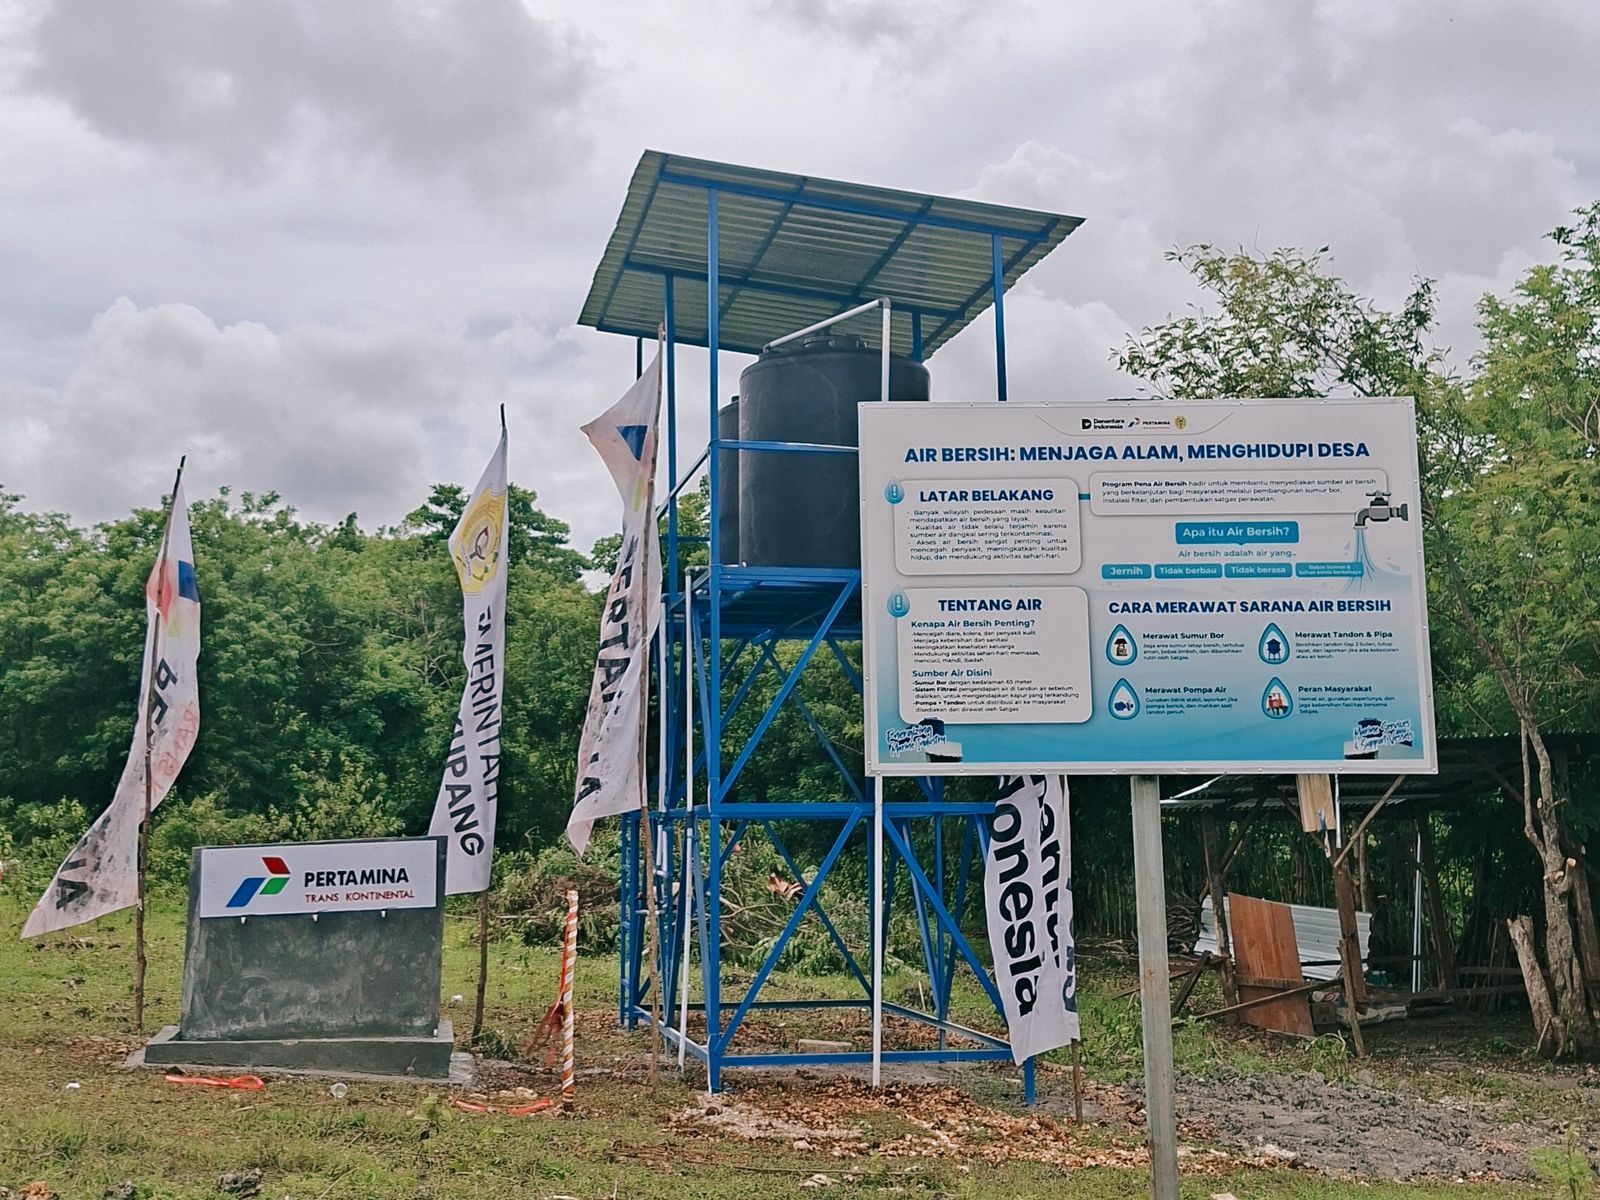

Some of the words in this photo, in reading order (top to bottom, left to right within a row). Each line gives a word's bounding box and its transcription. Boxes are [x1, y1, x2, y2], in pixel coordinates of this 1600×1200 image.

[904, 448, 936, 462] AIR
[942, 447, 1015, 462] BERSIH:
[1020, 446, 1118, 461] MENJAGA
[1122, 445, 1183, 462] ALAM,
[1188, 443, 1313, 459] MENGHIDUPI
[1318, 443, 1369, 457] DESA
[1270, 479, 1315, 487] menyediakan
[920, 490, 968, 502] LATAR
[972, 489, 1054, 501] BELAKANG
[1169, 488, 1184, 496] bagi
[1185, 488, 1226, 496] masyarakat
[1253, 487, 1304, 495] pembangunan
[1164, 496, 1213, 504] pembentukan
[1214, 496, 1236, 504] satgas
[973, 508, 1006, 516] pedesaan
[910, 516, 958, 524] mendapatkan
[1011, 515, 1029, 523] layak.
[978, 530, 999, 538] sering
[1183, 527, 1206, 538] Apa
[1209, 527, 1223, 536] itu
[1227, 527, 1244, 536] Air
[1247, 526, 1289, 536] Bersih?
[910, 546, 947, 554] mencegah
[987, 545, 1037, 553] meningkatkan
[1223, 549, 1253, 557] adalah
[1256, 549, 1268, 557] air
[949, 553, 991, 561] mendukung
[1110, 567, 1143, 575] Jernih
[1186, 566, 1217, 574] berbau
[1231, 566, 1255, 574] Tidak
[938, 600, 1012, 611] TENTANG
[1016, 599, 1042, 610] AIR
[1109, 602, 1152, 614] CARA
[1155, 601, 1236, 613] MERAWAT
[1240, 601, 1305, 612] SARANA
[1308, 601, 1333, 612] AIR
[1337, 600, 1391, 612] BERSIH
[911, 620, 945, 629] Kenapa
[995, 620, 1035, 628] Penting?
[1325, 685, 1372, 693] Masyarakat
[445, 716, 485, 857] UPANG
[304, 867, 410, 887] PERTAMINA
[305, 892, 339, 903] TRANS
[345, 890, 415, 902] KONTINENTAL
